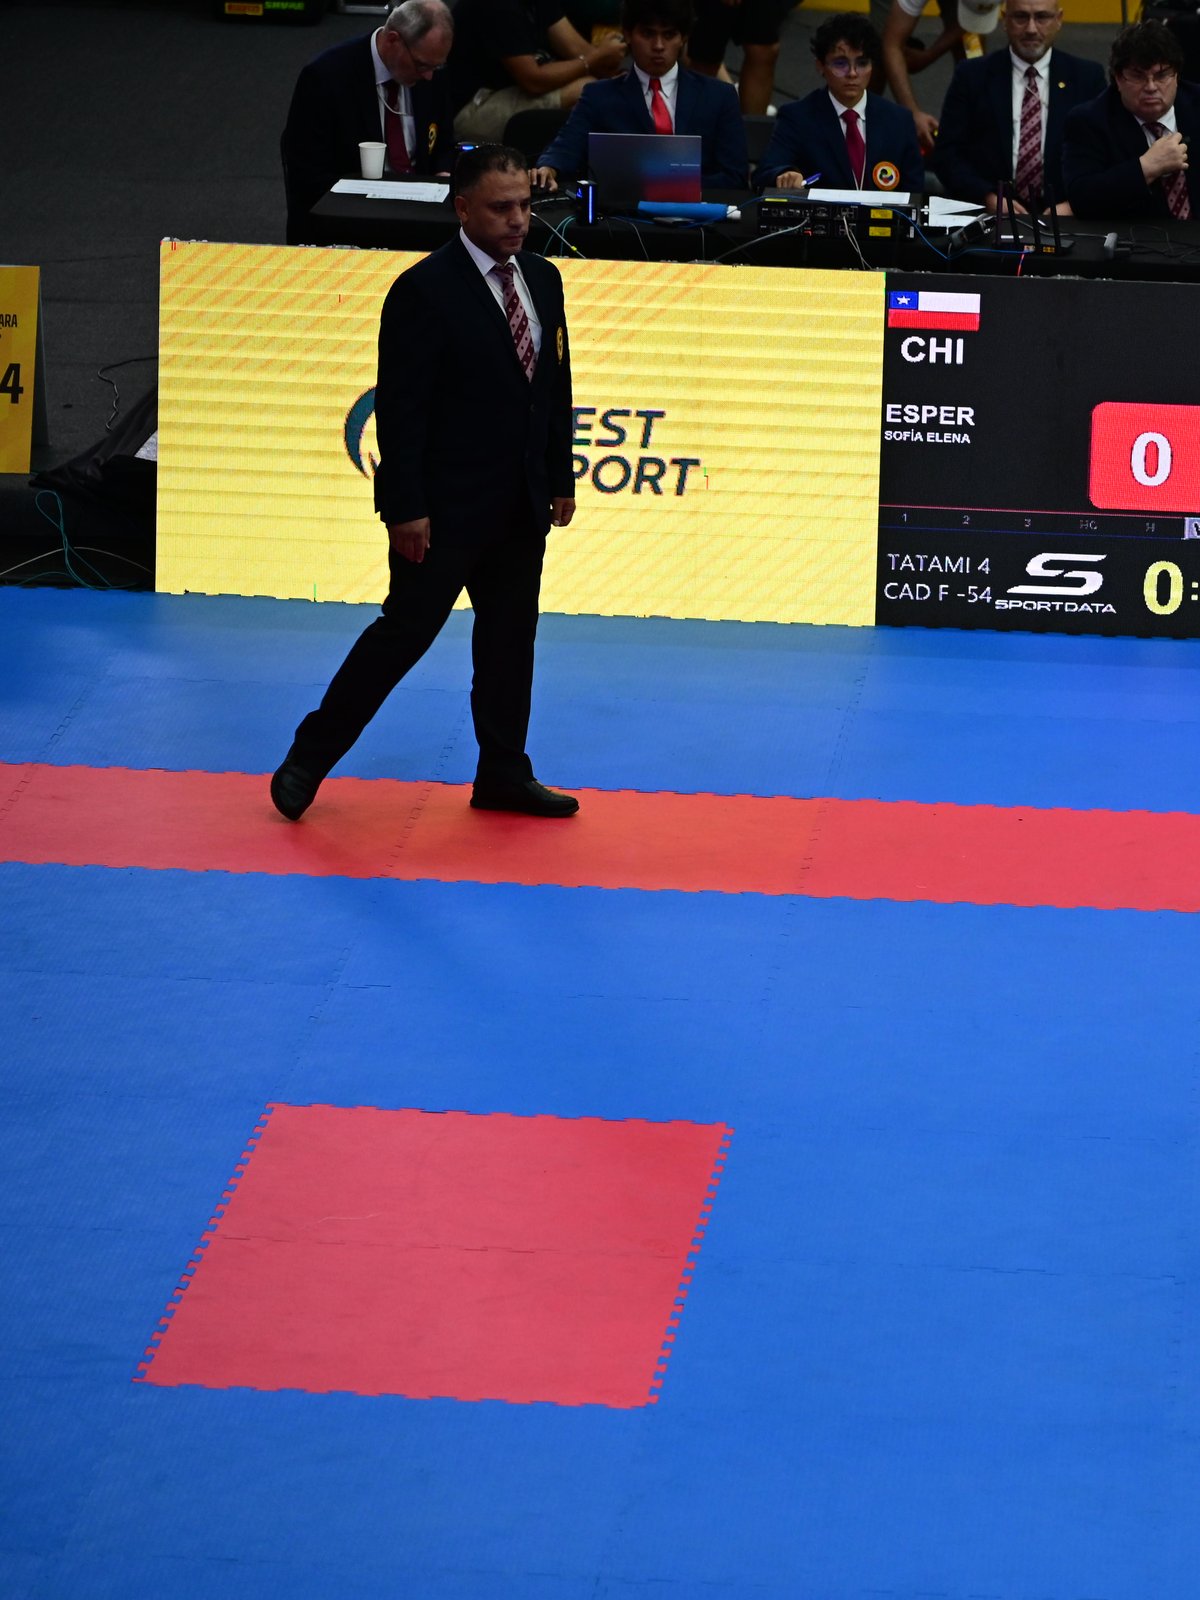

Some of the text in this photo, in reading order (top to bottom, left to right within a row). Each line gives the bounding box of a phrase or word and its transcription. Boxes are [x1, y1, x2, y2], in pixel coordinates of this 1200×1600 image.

[900, 336, 964, 365] CHI
[0, 363, 24, 404] 4
[886, 403, 976, 426] ESPER
[572, 407, 666, 449] EST
[926, 432, 971, 444] ELENA
[1131, 431, 1172, 487] 0
[573, 454, 701, 497] ORT
[962, 515, 970, 525] 2
[1024, 518, 1032, 528] 3
[887, 553, 991, 575] TATAMI 4
[884, 583, 993, 604] CAD F -54
[994, 599, 1117, 614] SPORTDATA
